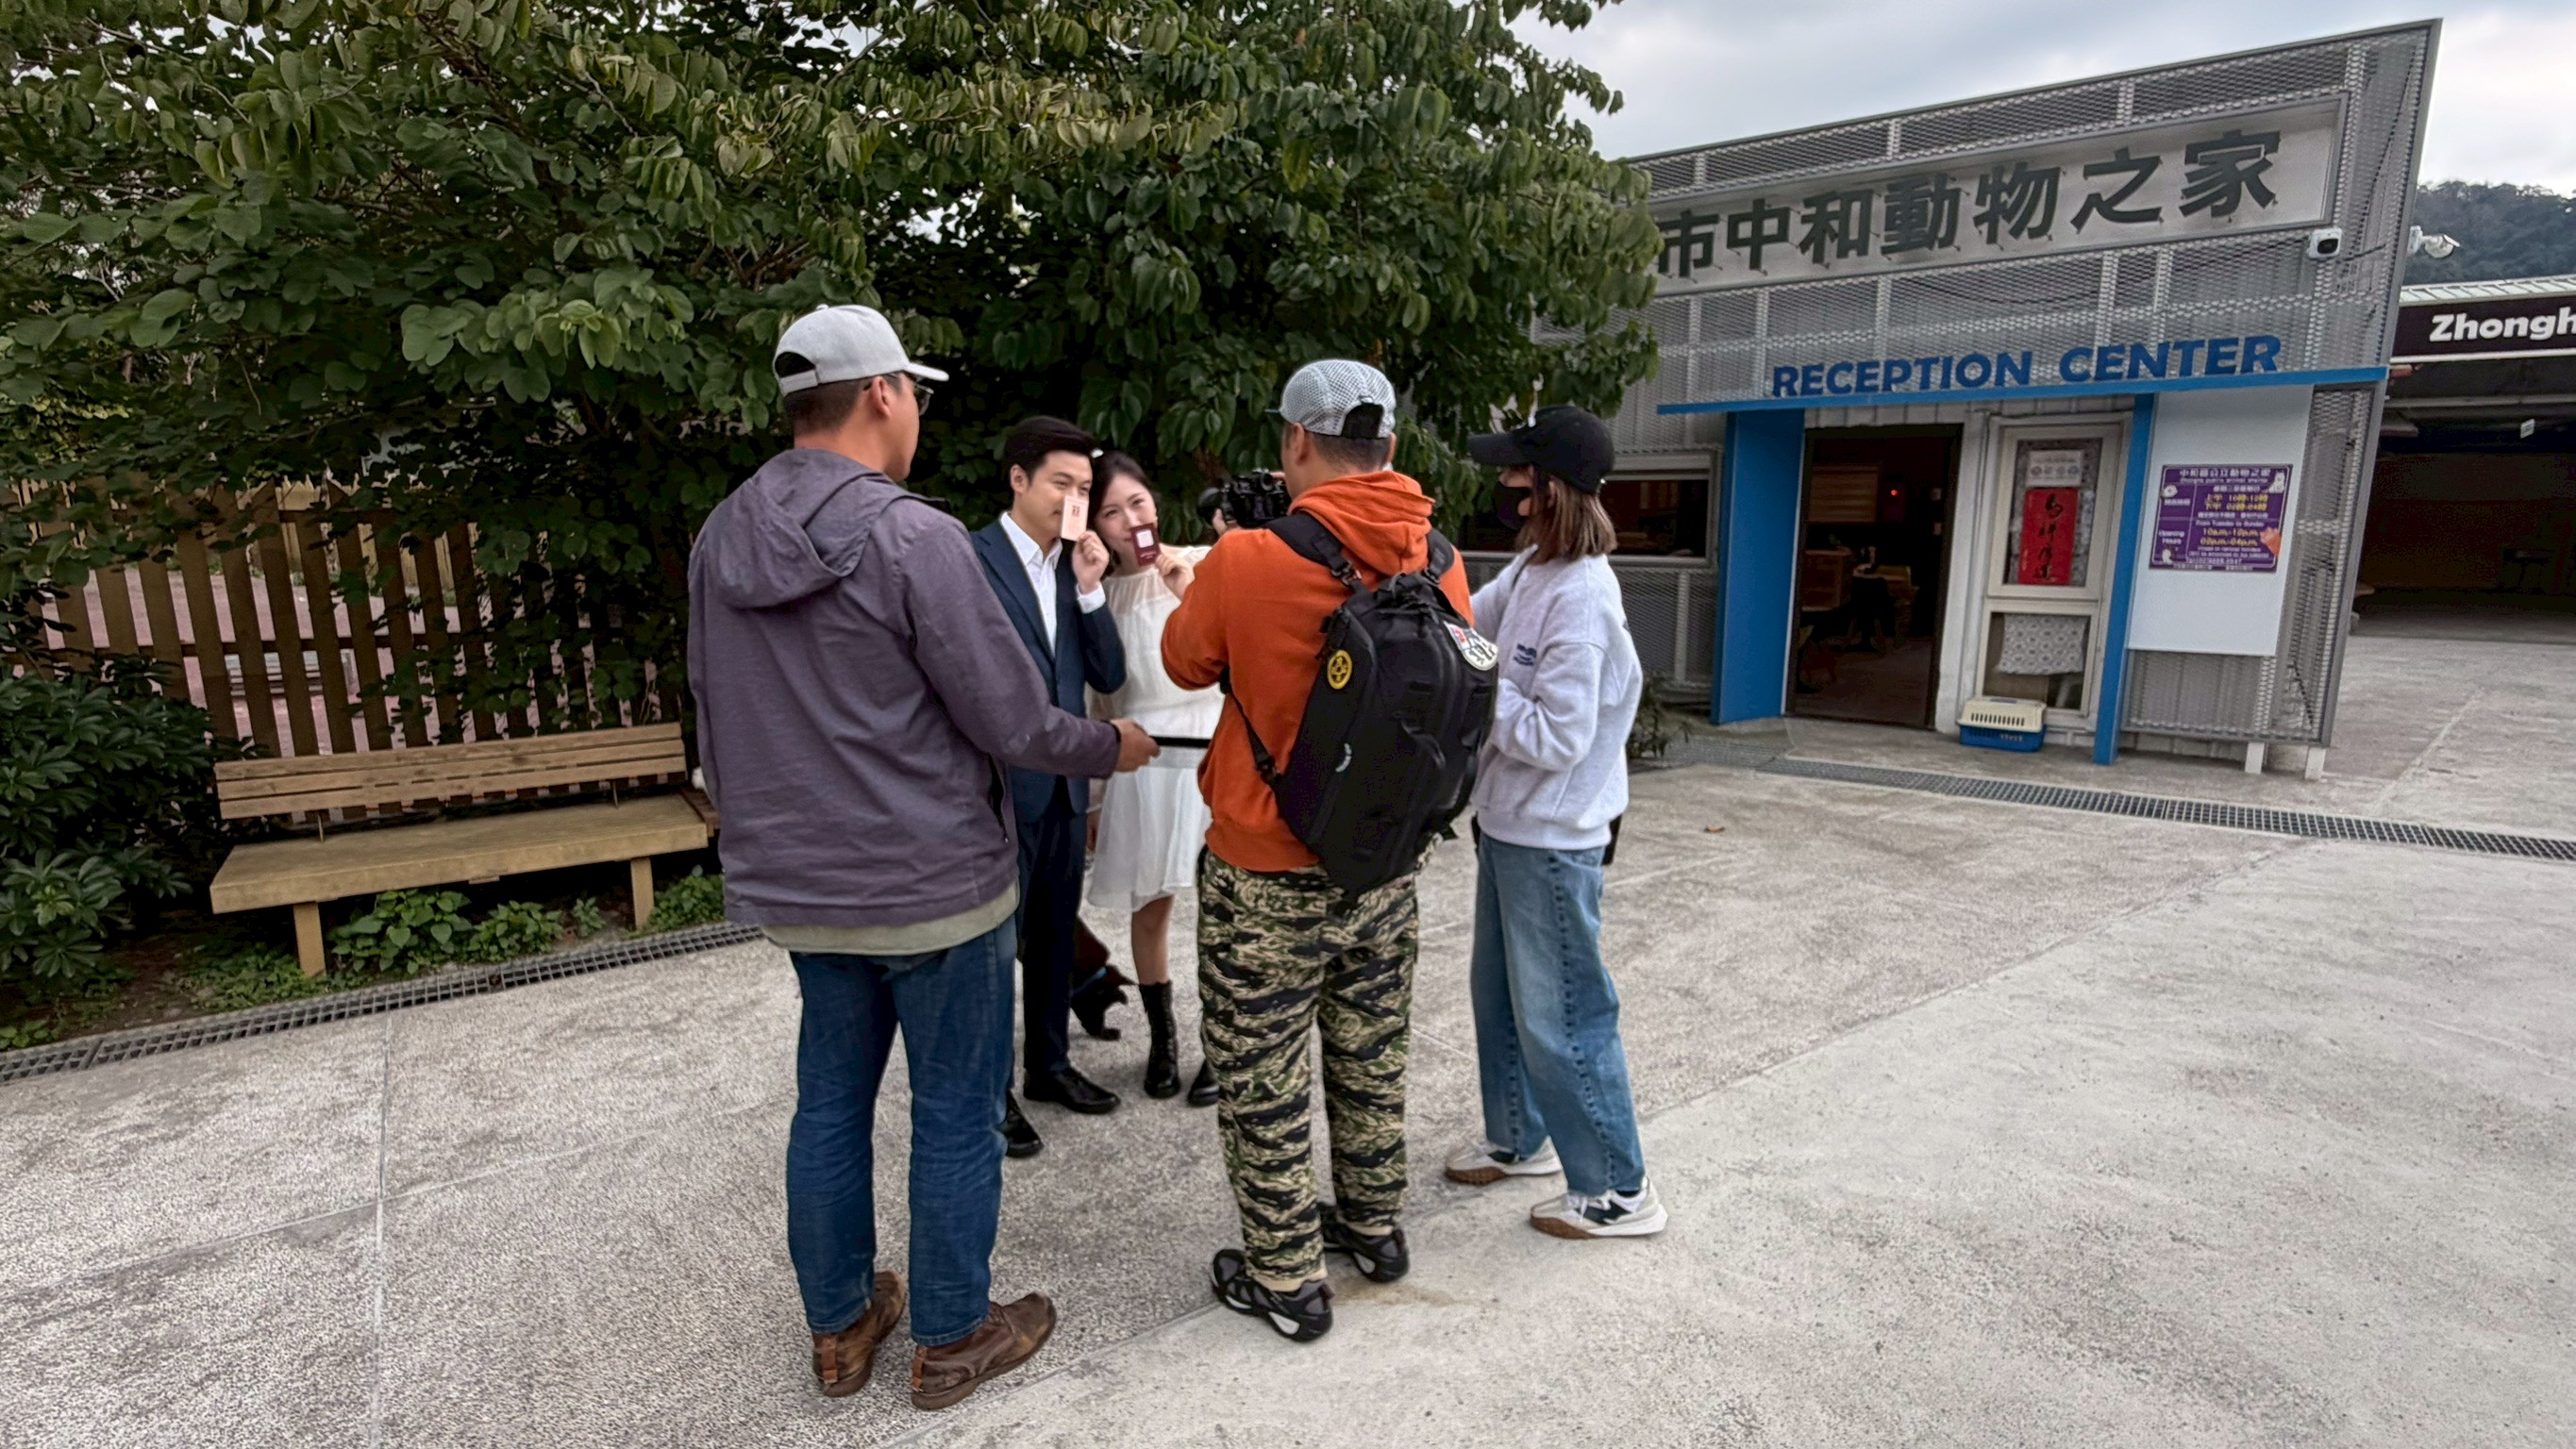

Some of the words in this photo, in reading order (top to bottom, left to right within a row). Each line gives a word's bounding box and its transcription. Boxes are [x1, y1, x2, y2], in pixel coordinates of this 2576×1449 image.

[1656, 129, 2282, 278] 市中和動物之家
[2429, 306, 2576, 342] Zhongh
[1772, 350, 2033, 398] RECEPTION
[2059, 334, 2282, 383] CENTER
